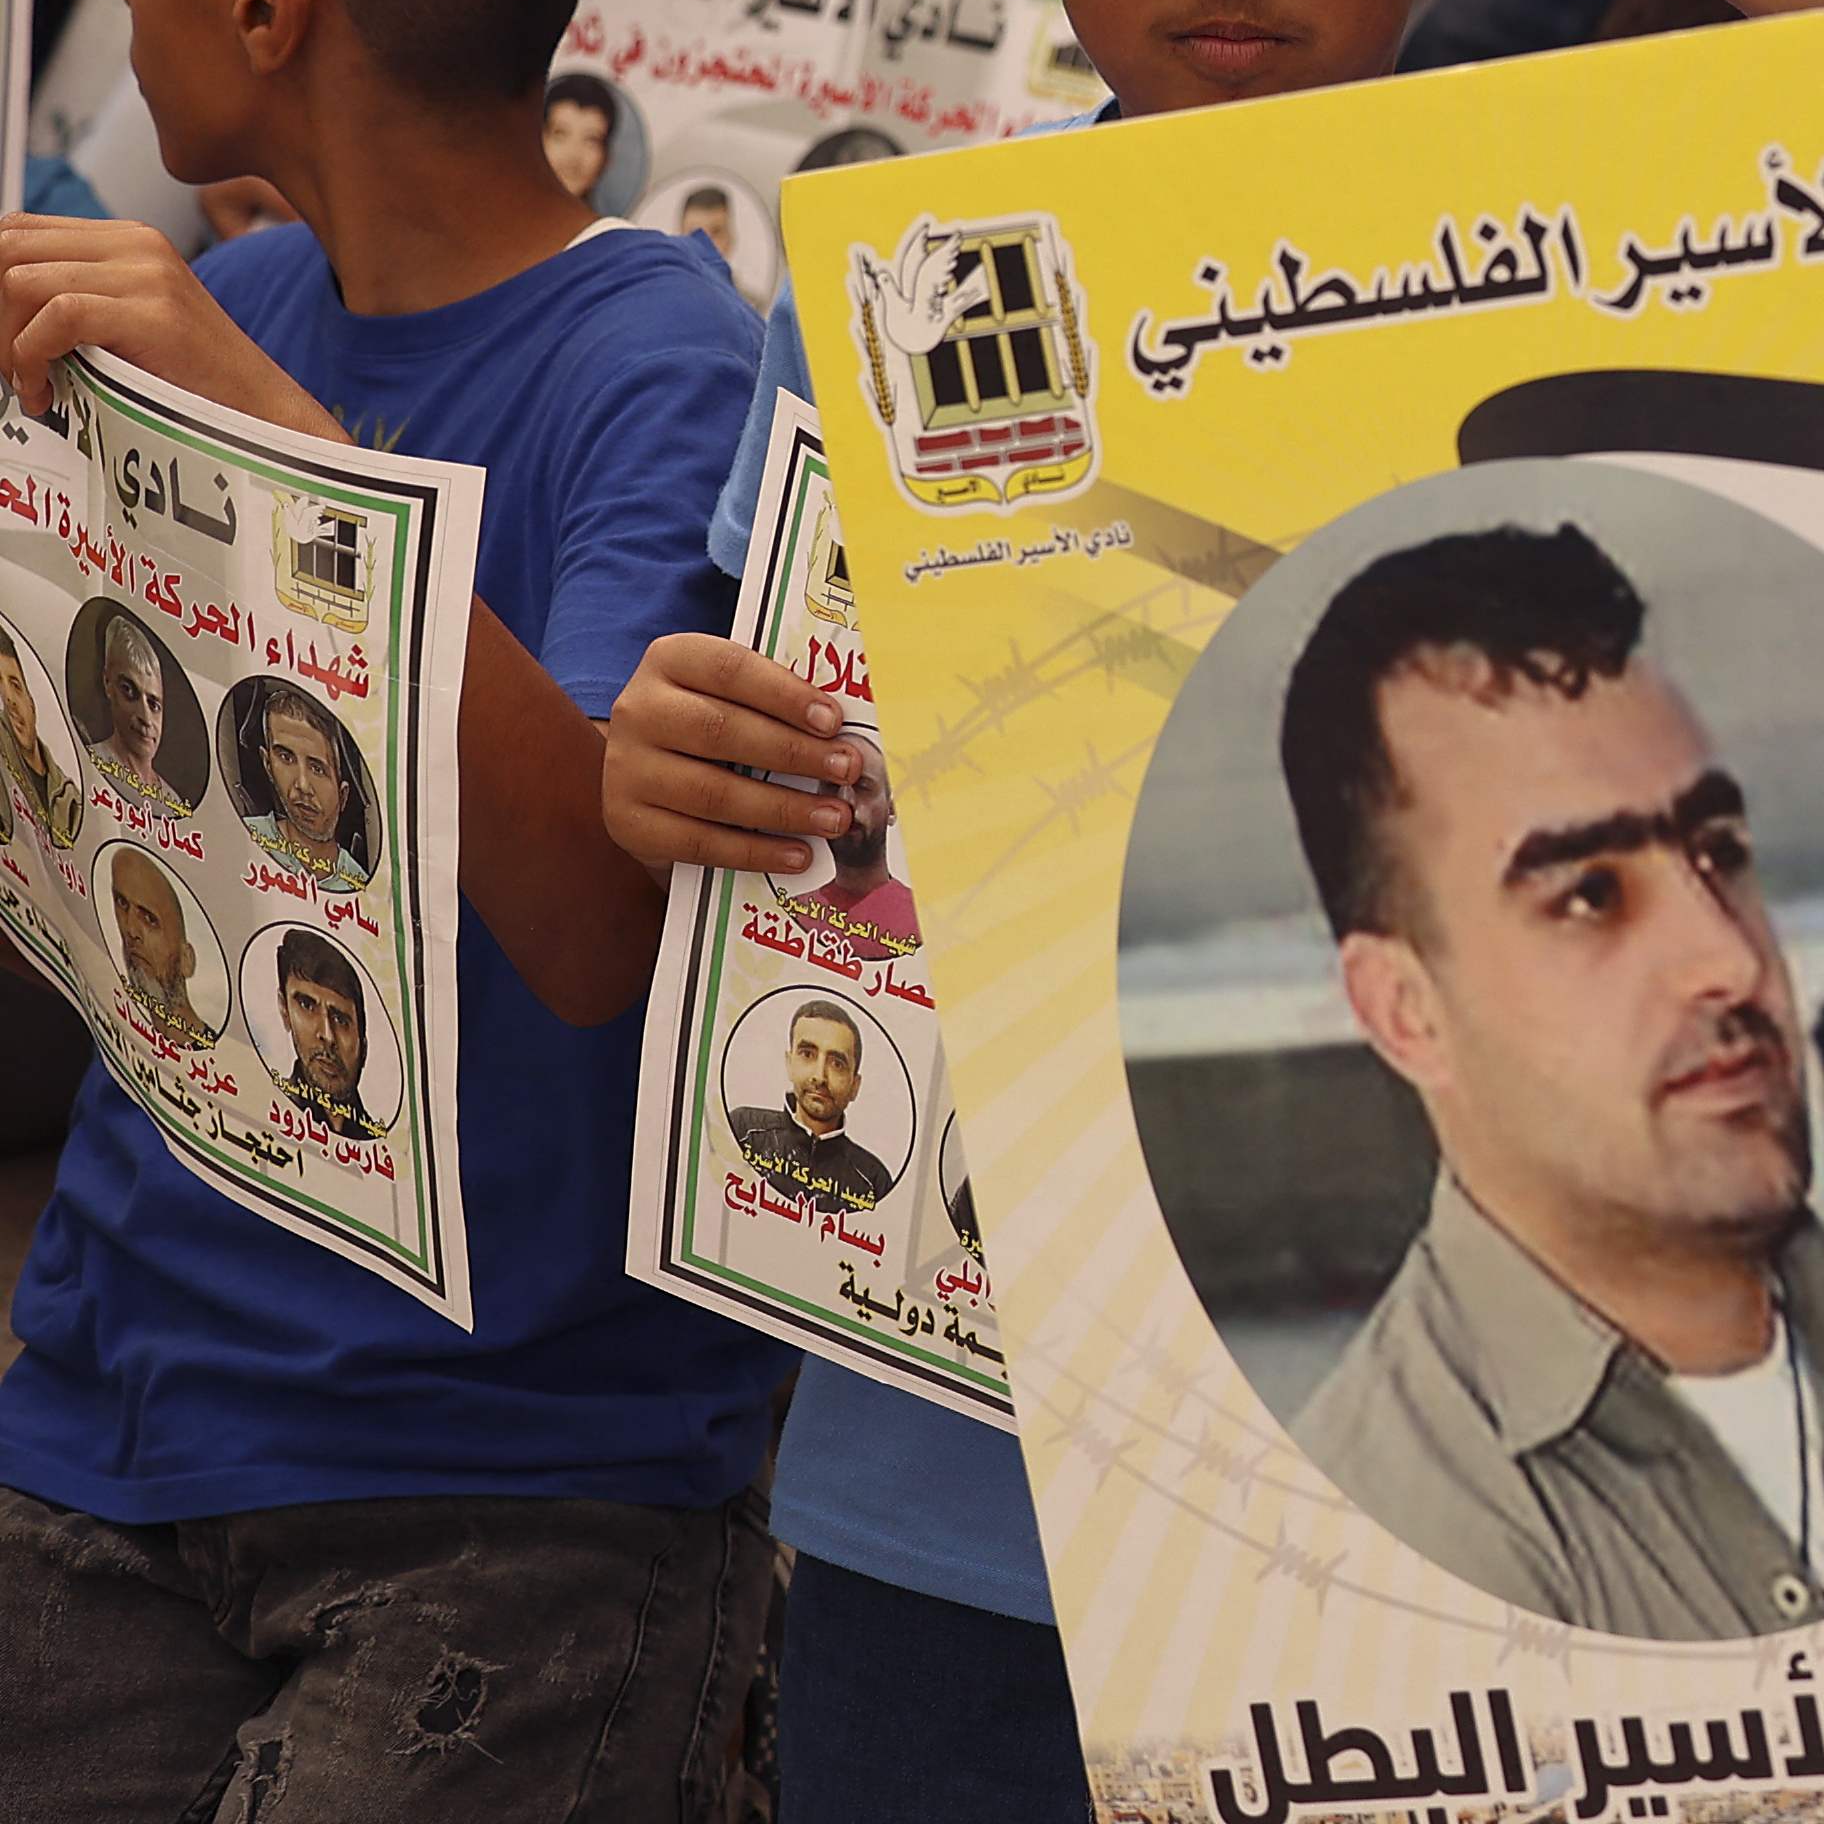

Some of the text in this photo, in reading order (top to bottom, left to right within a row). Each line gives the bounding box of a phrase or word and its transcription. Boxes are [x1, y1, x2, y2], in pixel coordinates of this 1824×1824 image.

[1130, 200, 1584, 398] الفلسطيني
[57, 491, 137, 595] الأسيرة
[113, 448, 238, 546] نادي
[904, 524, 1132, 584] نادي الأسير الفلسطيني
[142, 553, 257, 653] الحركة
[266, 628, 370, 702] شهداء
[241, 862, 379, 938] سامي العمور
[741, 902, 936, 1011] صار طقاطقة
[205, 1101, 305, 1178] احتجاز
[269, 1099, 396, 1181] فارس بارود
[724, 1171, 886, 1268] بسام السايح
[838, 1260, 935, 1336] دولية
[1210, 1686, 1528, 1824] البطل
